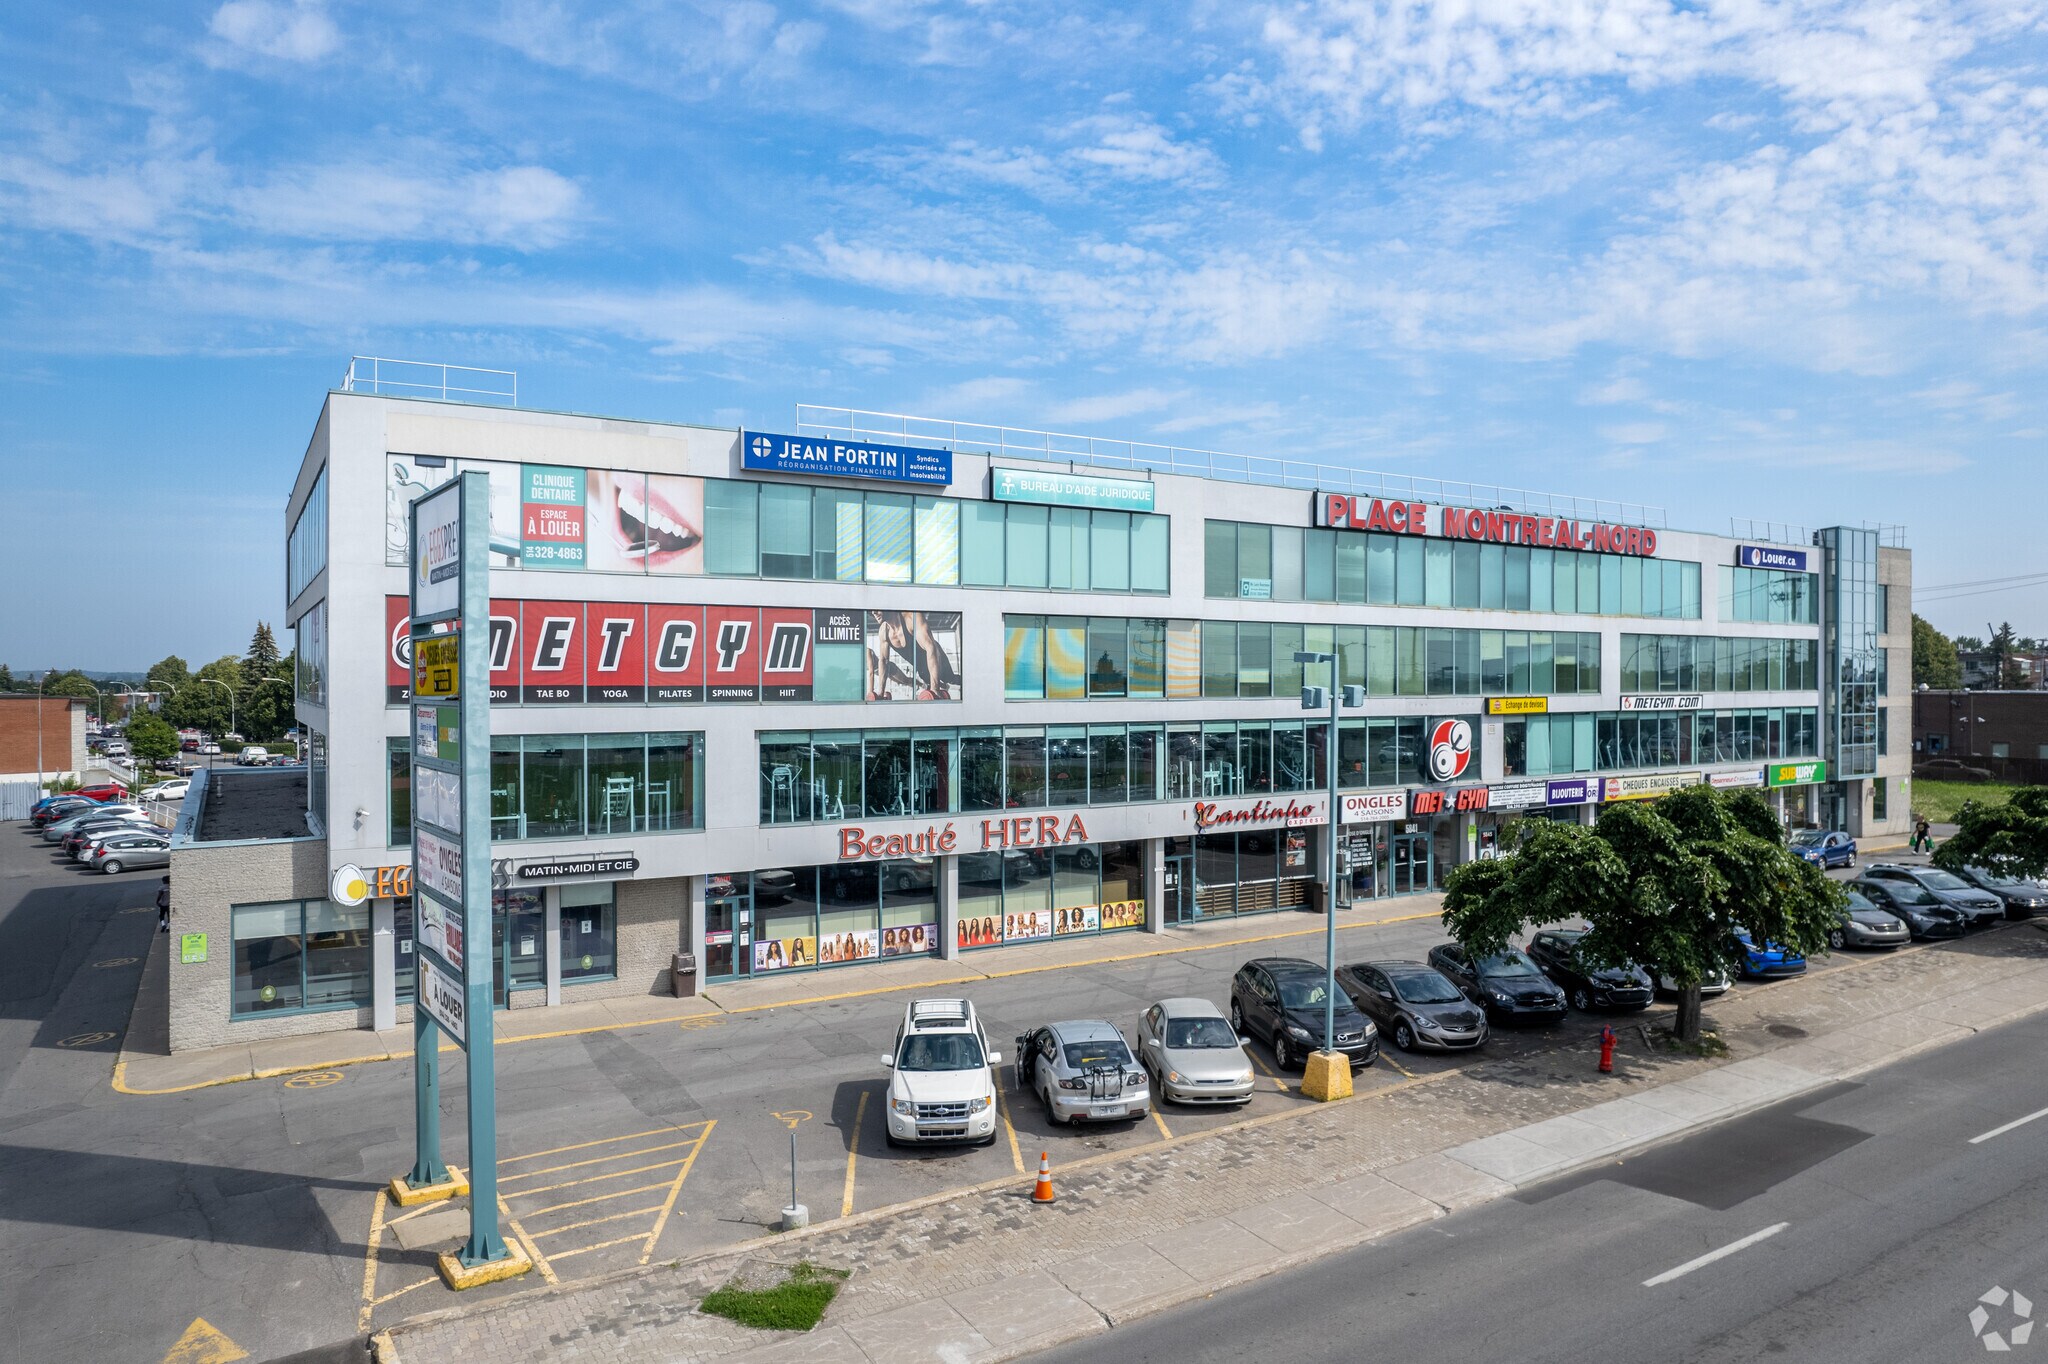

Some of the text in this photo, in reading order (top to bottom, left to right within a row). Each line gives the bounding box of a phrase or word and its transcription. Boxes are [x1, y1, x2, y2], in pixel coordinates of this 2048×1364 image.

[779, 441, 897, 467] JEAN FORTIN
[917, 454, 939, 463] Syndics
[778, 460, 897, 477] RÉORGANISATION FINANCIÈRE
[910, 464, 937, 472] autorisés
[533, 474, 575, 488] CLINIQUE
[910, 472, 946, 480] insolvabilité
[531, 488, 576, 501] DENTAIRE
[1021, 480, 1151, 501] BUREAU D'AIDE JURIDIQUE
[541, 509, 567, 519] ESPACE
[527, 516, 580, 536] À LOUER
[1327, 494, 1657, 557] PLACE MONTREAL-NORD
[535, 546, 583, 559] 328-4863
[1762, 551, 1796, 566] Louer.ca
[829, 614, 850, 626] ACCÈS
[820, 624, 860, 641] ILLIMITÉ
[537, 690, 554, 698] TAE
[603, 690, 628, 698] YOGA
[659, 690, 692, 698] PILATES
[712, 689, 753, 697] SPINNING
[779, 689, 795, 697] HIIT
[1634, 696, 1699, 708] METGYM.COM
[1779, 764, 1818, 781] SUBWAY
[1623, 780, 1648, 790] CHEQUES
[1650, 777, 1679, 788] ENCAISSES
[1552, 787, 1584, 799] BIJOUTERIE
[1347, 796, 1402, 810] ONGLES
[1414, 792, 1446, 814] MET
[1457, 788, 1489, 811] GYM
[1202, 799, 1315, 825] Cantinho
[1361, 808, 1394, 816] SAISONS
[1288, 818, 1324, 826] express
[840, 814, 1089, 858] Beauté HERA
[439, 846, 461, 878] ONGLES
[598, 862, 610, 871] ET
[614, 861, 633, 870] CIE
[440, 987, 463, 1023] LOUER
